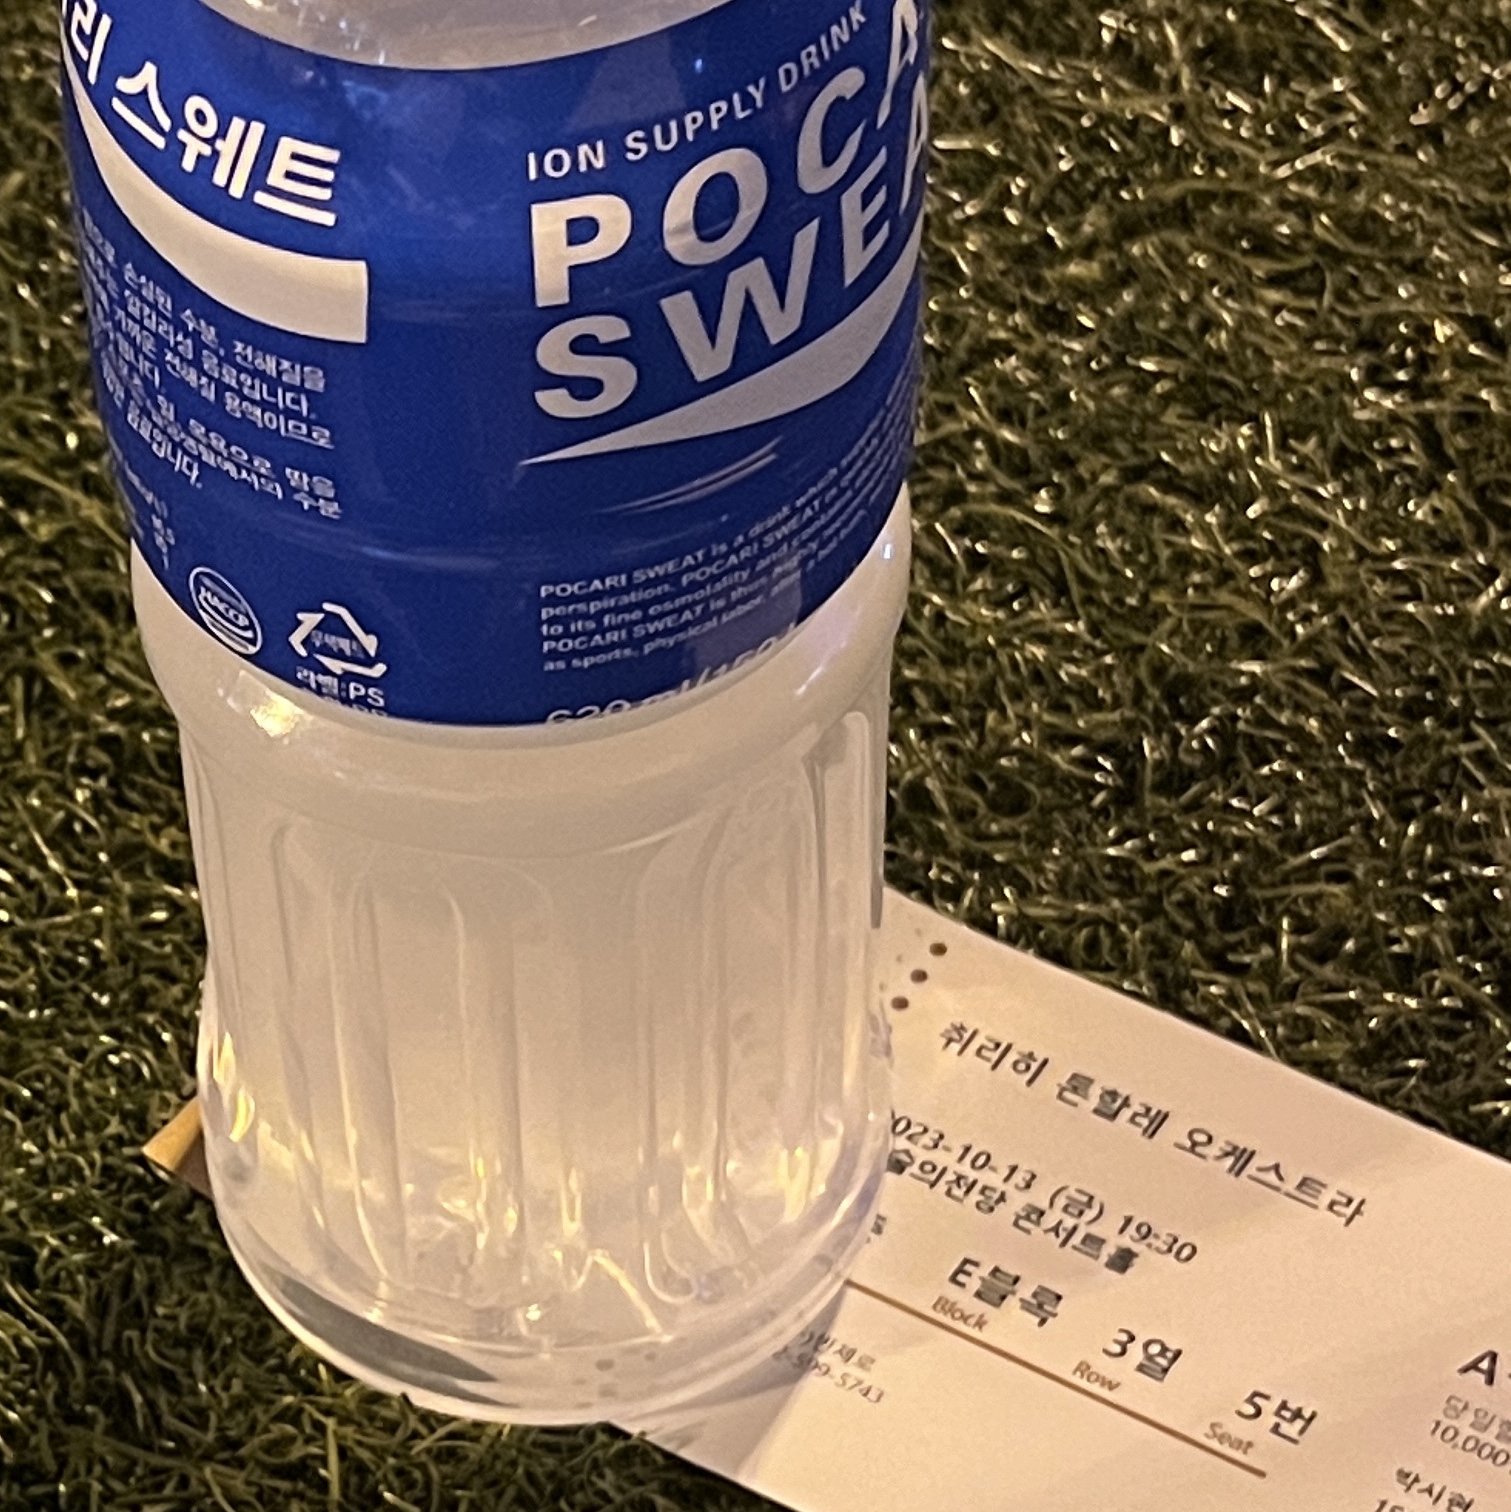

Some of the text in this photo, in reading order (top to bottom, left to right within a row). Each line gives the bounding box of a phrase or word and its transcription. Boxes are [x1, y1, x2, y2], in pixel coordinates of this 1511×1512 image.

[62, 0, 340, 226] 리 스웨트
[527, 0, 867, 181] ION SUPPLY DRINK
[201, 349, 317, 419] 음료입니다.
[234, 340, 326, 392] 전해질을
[223, 390, 336, 450] 용액이므로
[540, 572, 628, 598] POCARI
[632, 548, 707, 585] SWEAT
[711, 541, 728, 557] is
[540, 583, 677, 621] perspiration.
[681, 541, 760, 588] POCARI
[540, 623, 564, 637] to
[569, 616, 597, 634] its
[602, 606, 644, 627] fine
[542, 629, 628, 654] POCARI
[632, 602, 707, 639] SWEAT
[543, 658, 566, 672] as
[571, 645, 639, 669] sports,
[938, 1019, 1049, 1087] 취리히
[1173, 1127, 1367, 1229] 오케스트라
[890, 1107, 1198, 1264] 023-10-13 (금) 19:30
[1012, 1202, 1139, 1276] 콘서트홀
[932, 1294, 1255, 1458] Block Row Seat
[948, 1256, 1319, 1446] E블록 3열 5번
[1456, 1348, 1511, 1388] A
[1431, 1419, 1511, 1476] 10,000
